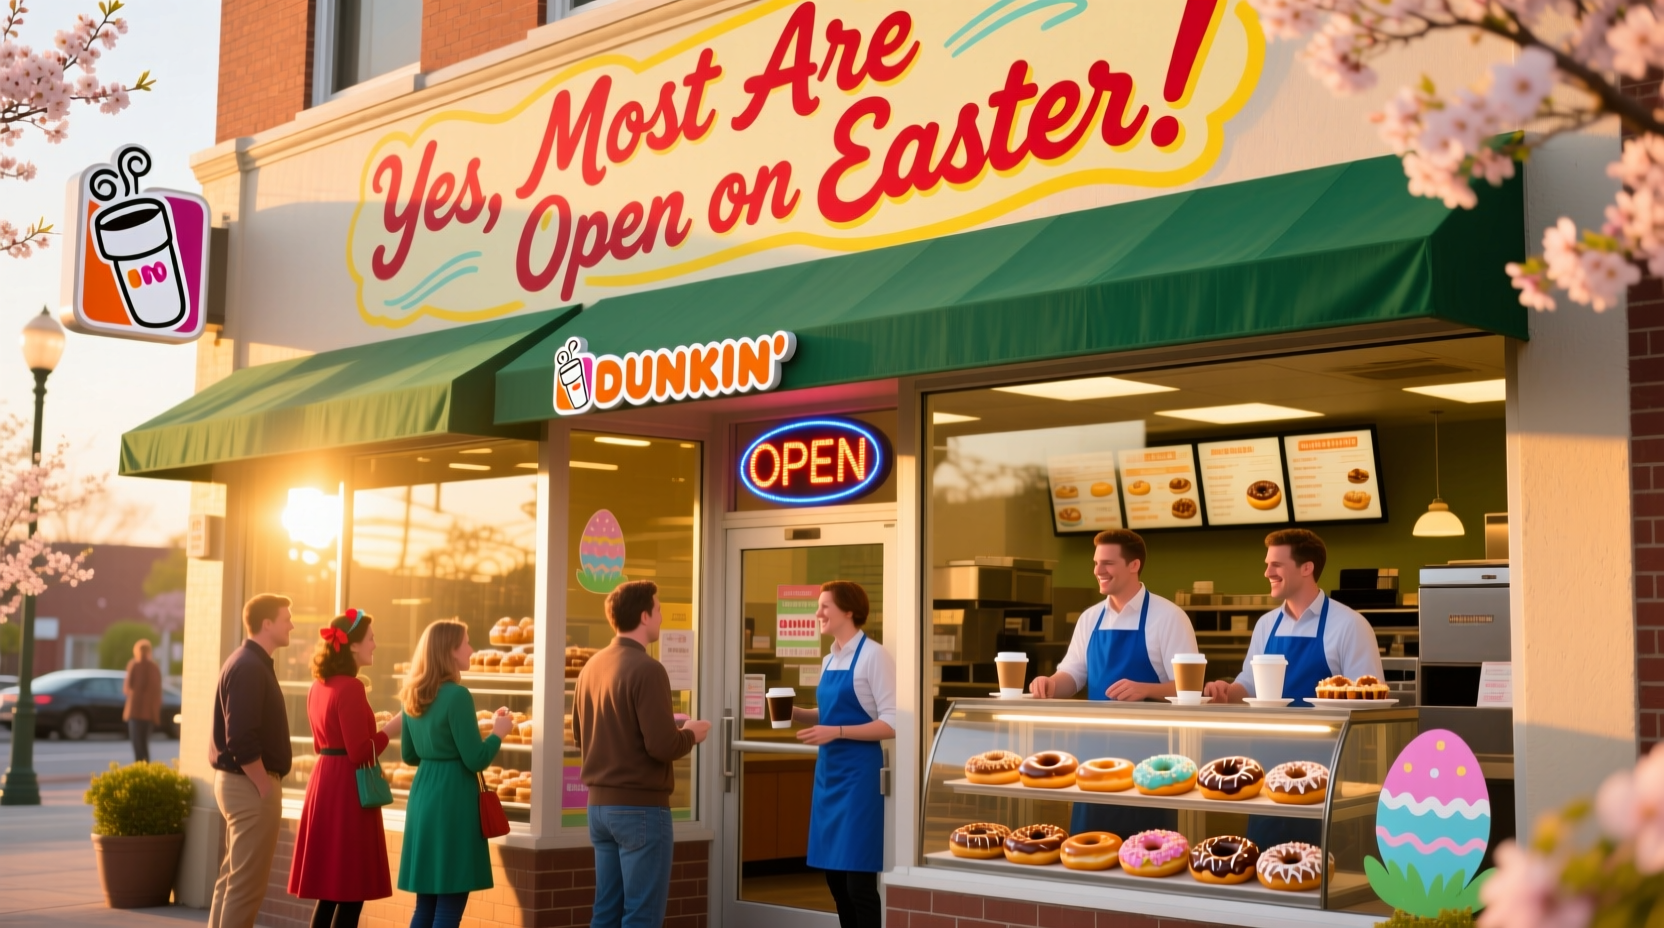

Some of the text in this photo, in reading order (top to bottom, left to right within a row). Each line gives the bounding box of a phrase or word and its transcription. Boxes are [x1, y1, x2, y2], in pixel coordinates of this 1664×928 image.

[373, 1, 920, 280] Yes, Most Are
[516, 0, 1218, 301] Open on Easter!
[595, 336, 785, 402] DUNKIN'
[749, 436, 867, 488] OPEN
